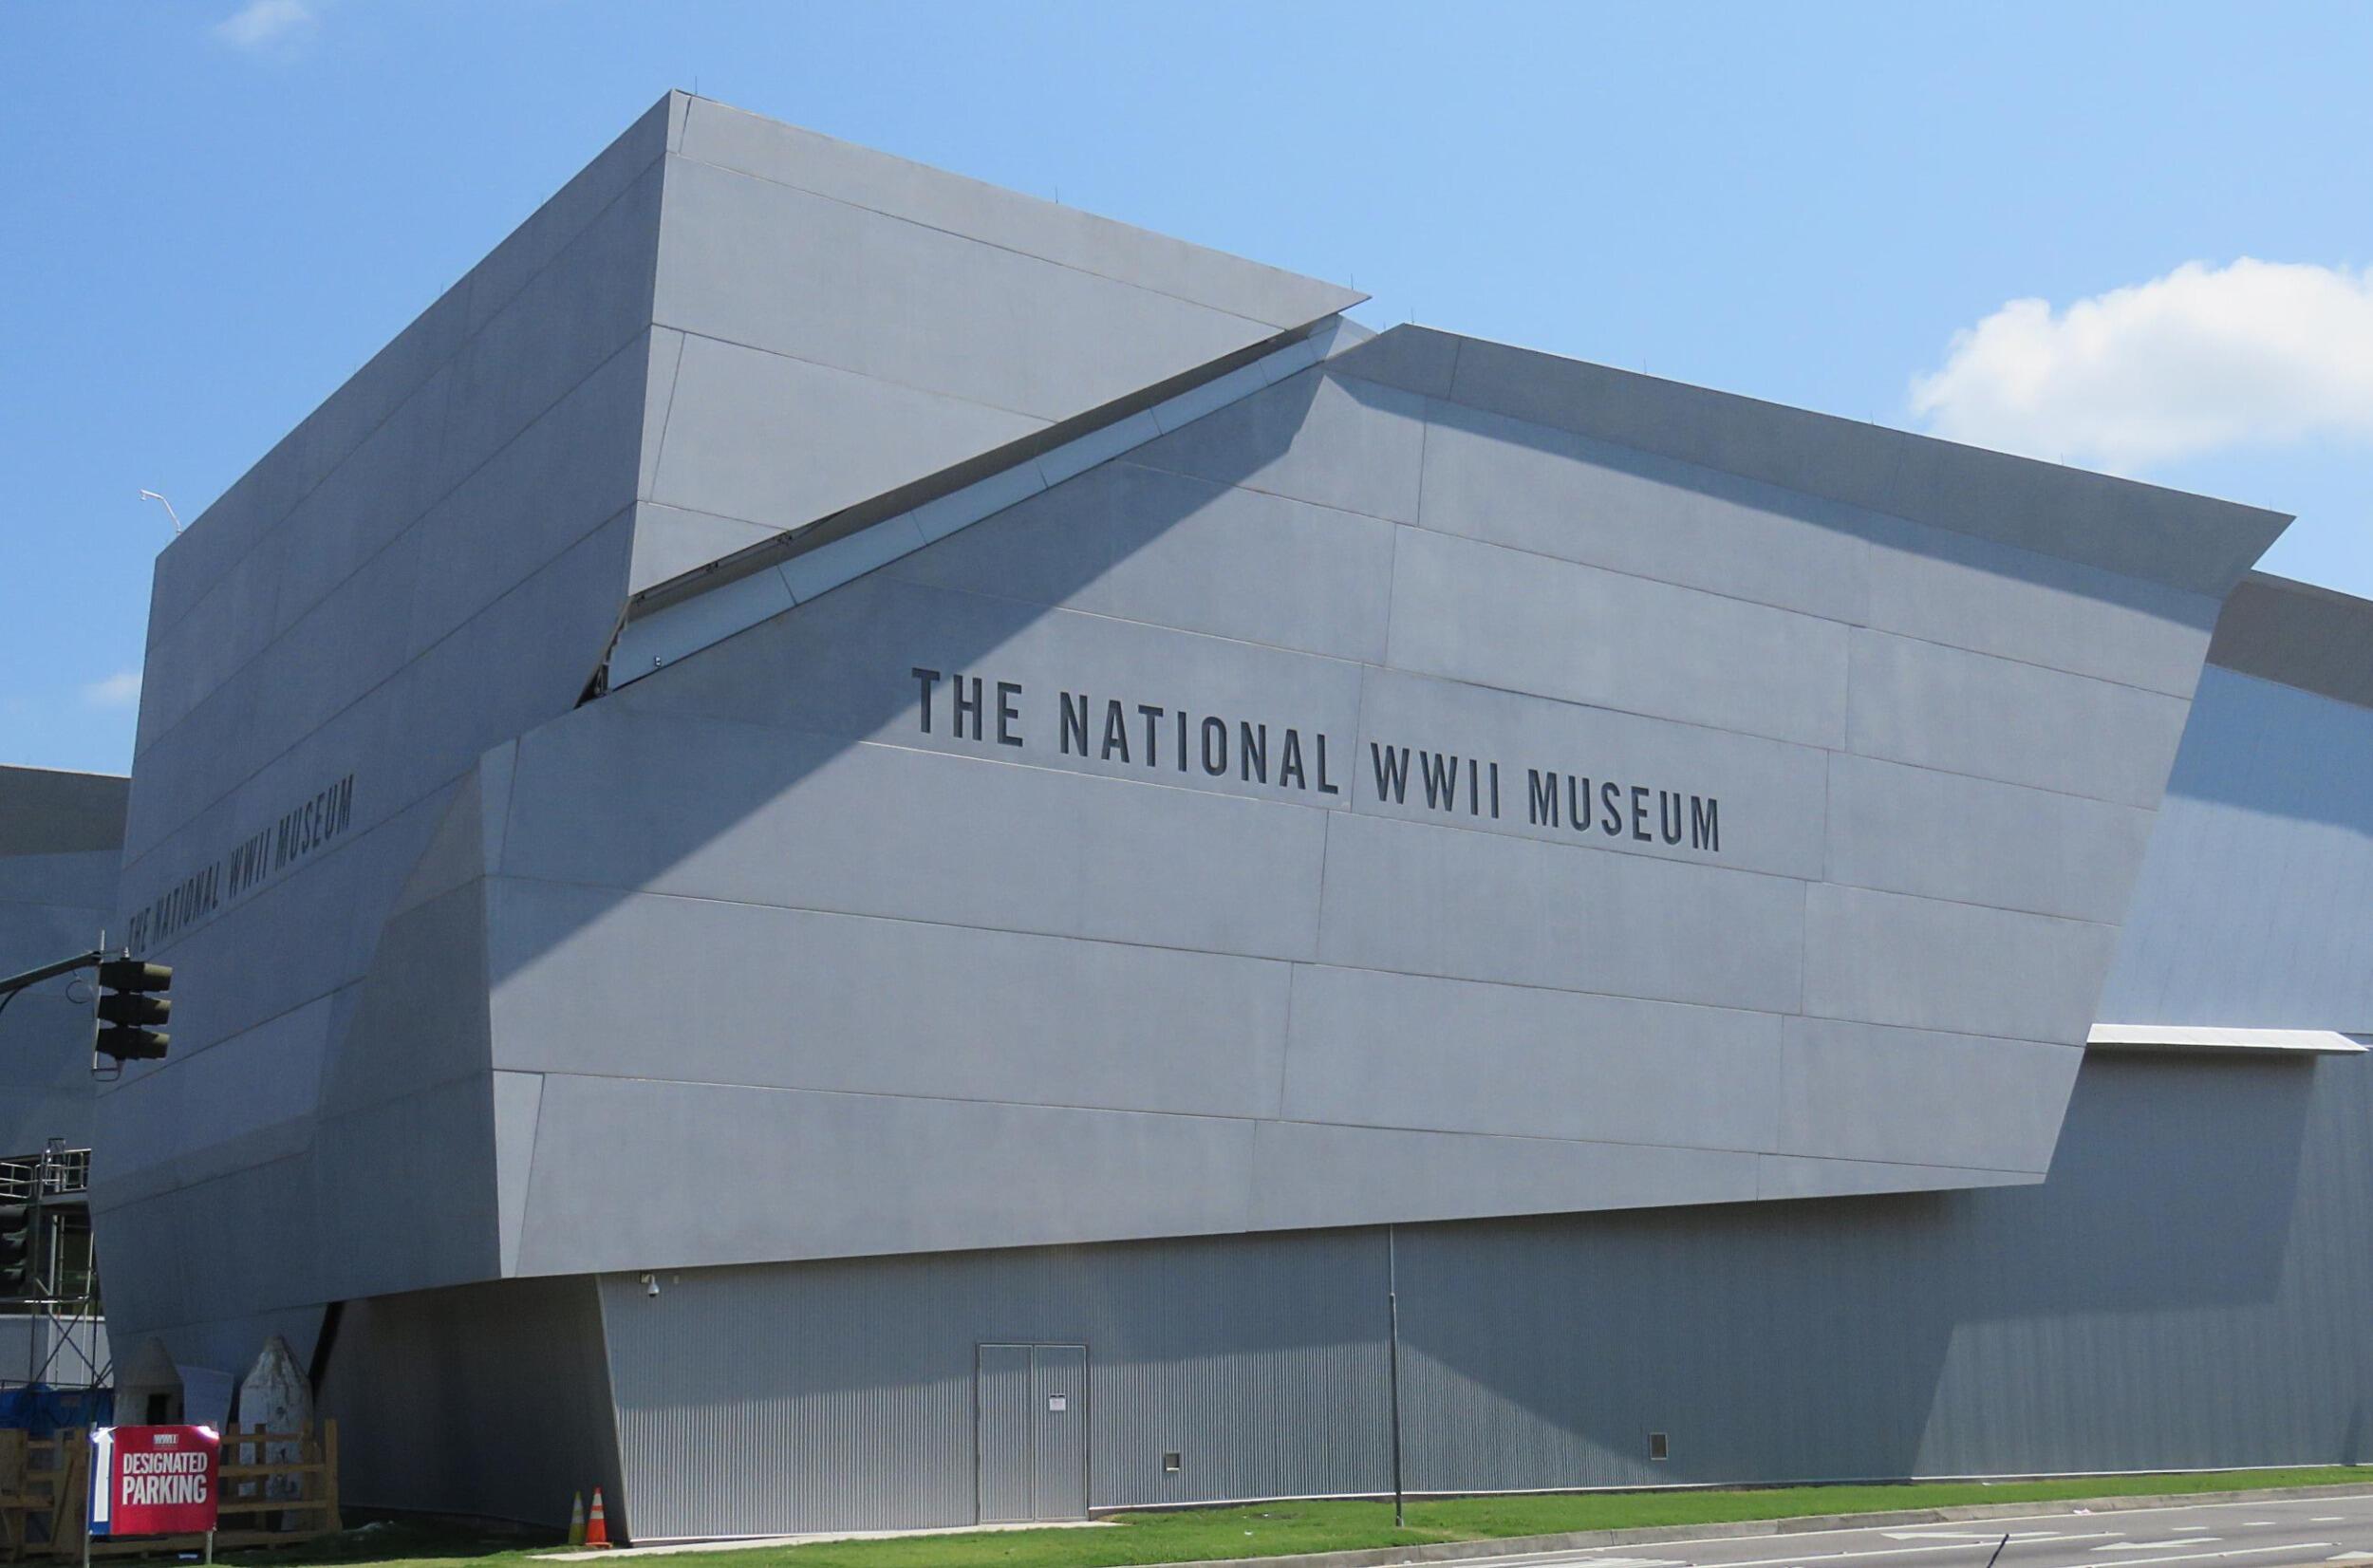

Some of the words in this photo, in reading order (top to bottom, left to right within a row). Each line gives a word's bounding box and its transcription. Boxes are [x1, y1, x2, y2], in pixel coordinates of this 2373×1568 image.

[911, 666, 1023, 748] THE
[1059, 691, 1339, 795] NATIONAL
[1370, 741, 1500, 819] WWII
[1526, 768, 1720, 852] MUSEUM
[127, 906, 151, 957] THE
[152, 860, 220, 946] NATIONAL
[229, 827, 271, 900] WWII
[274, 774, 354, 871] MUSEUM
[121, 1474, 207, 1505] PARKING
[122, 1451, 208, 1474] DESIGNATED
